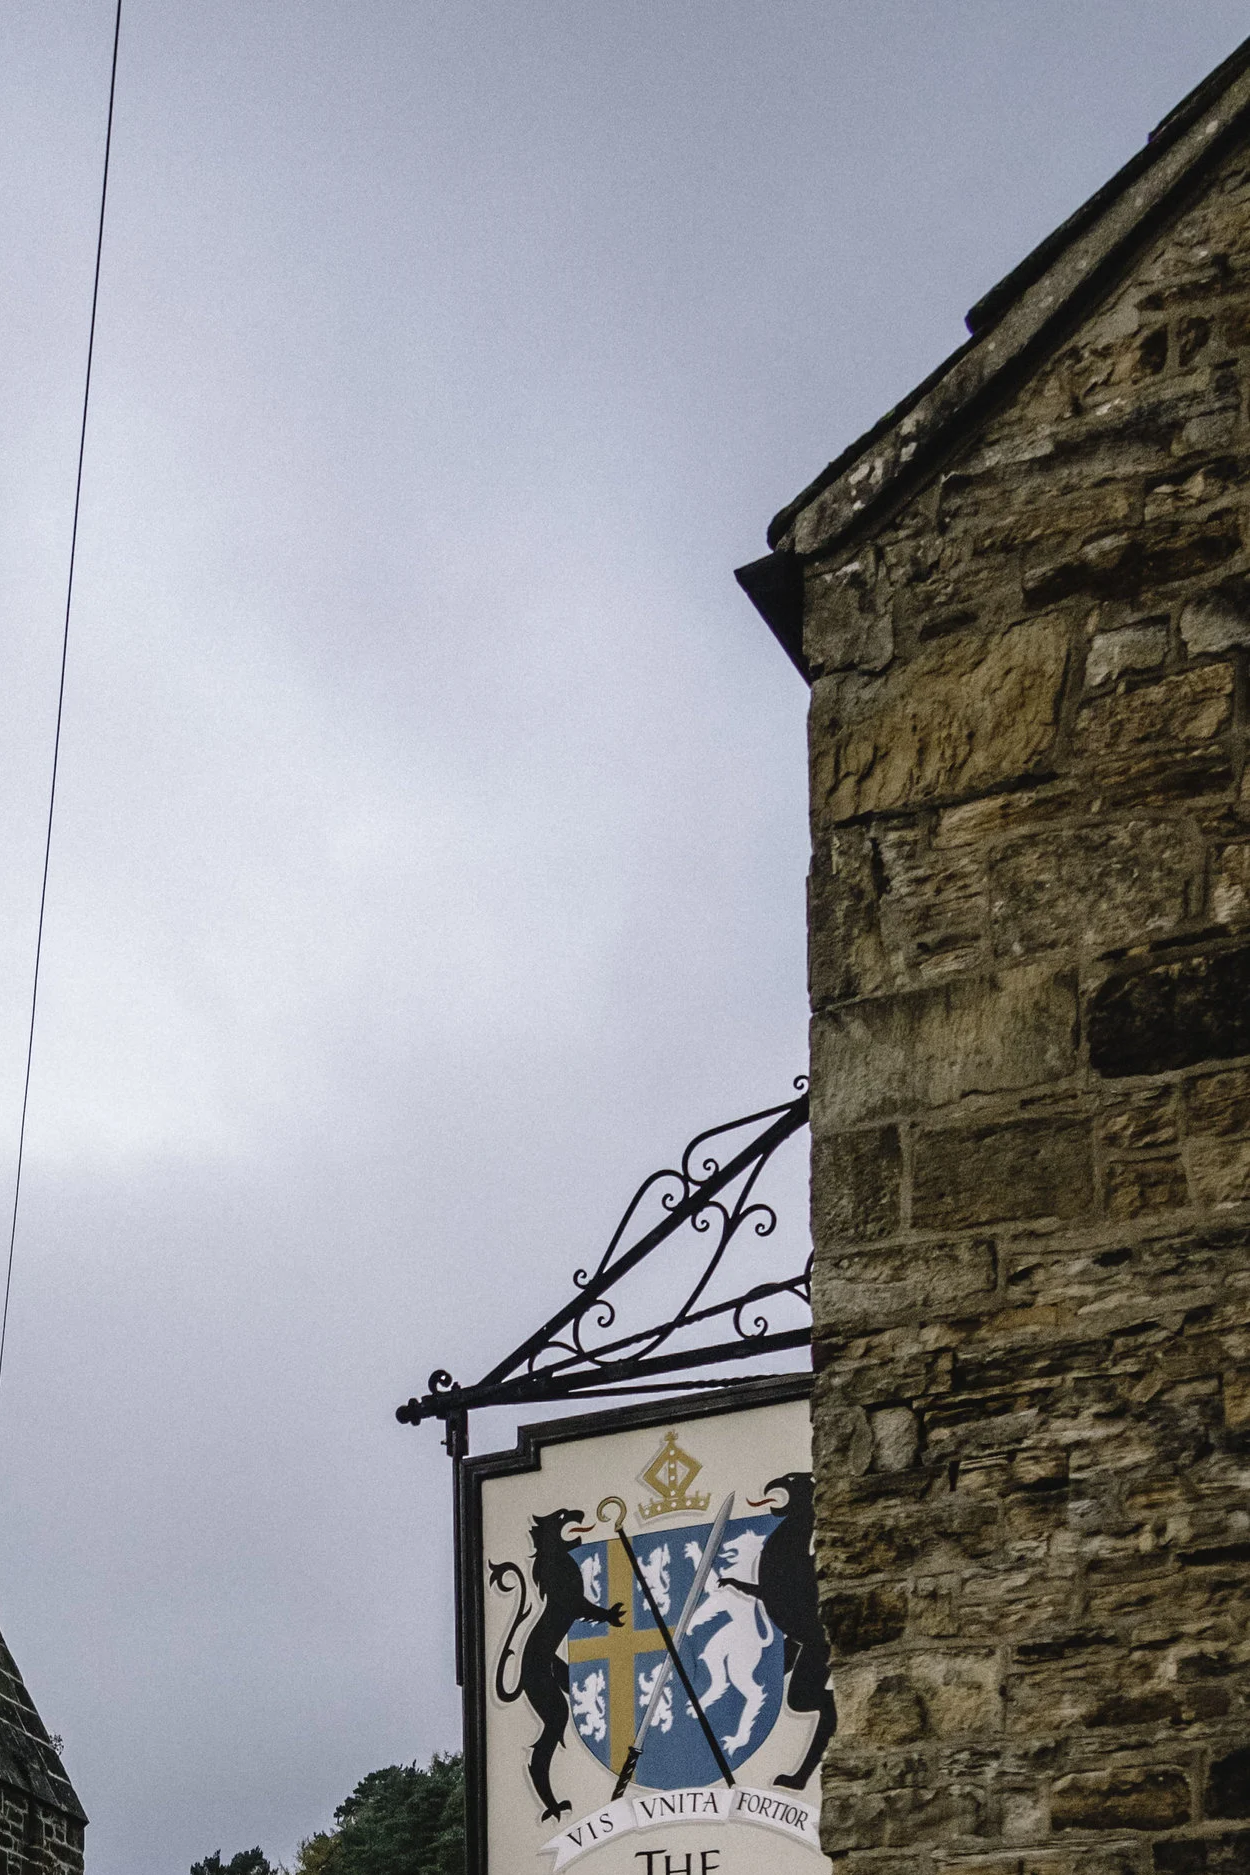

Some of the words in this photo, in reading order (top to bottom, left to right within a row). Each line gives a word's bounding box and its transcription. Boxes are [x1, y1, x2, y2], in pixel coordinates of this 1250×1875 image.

[566, 1812, 615, 1850] VIS
[639, 1791, 720, 1821] VNITA
[736, 1790, 809, 1832] FORTIOR
